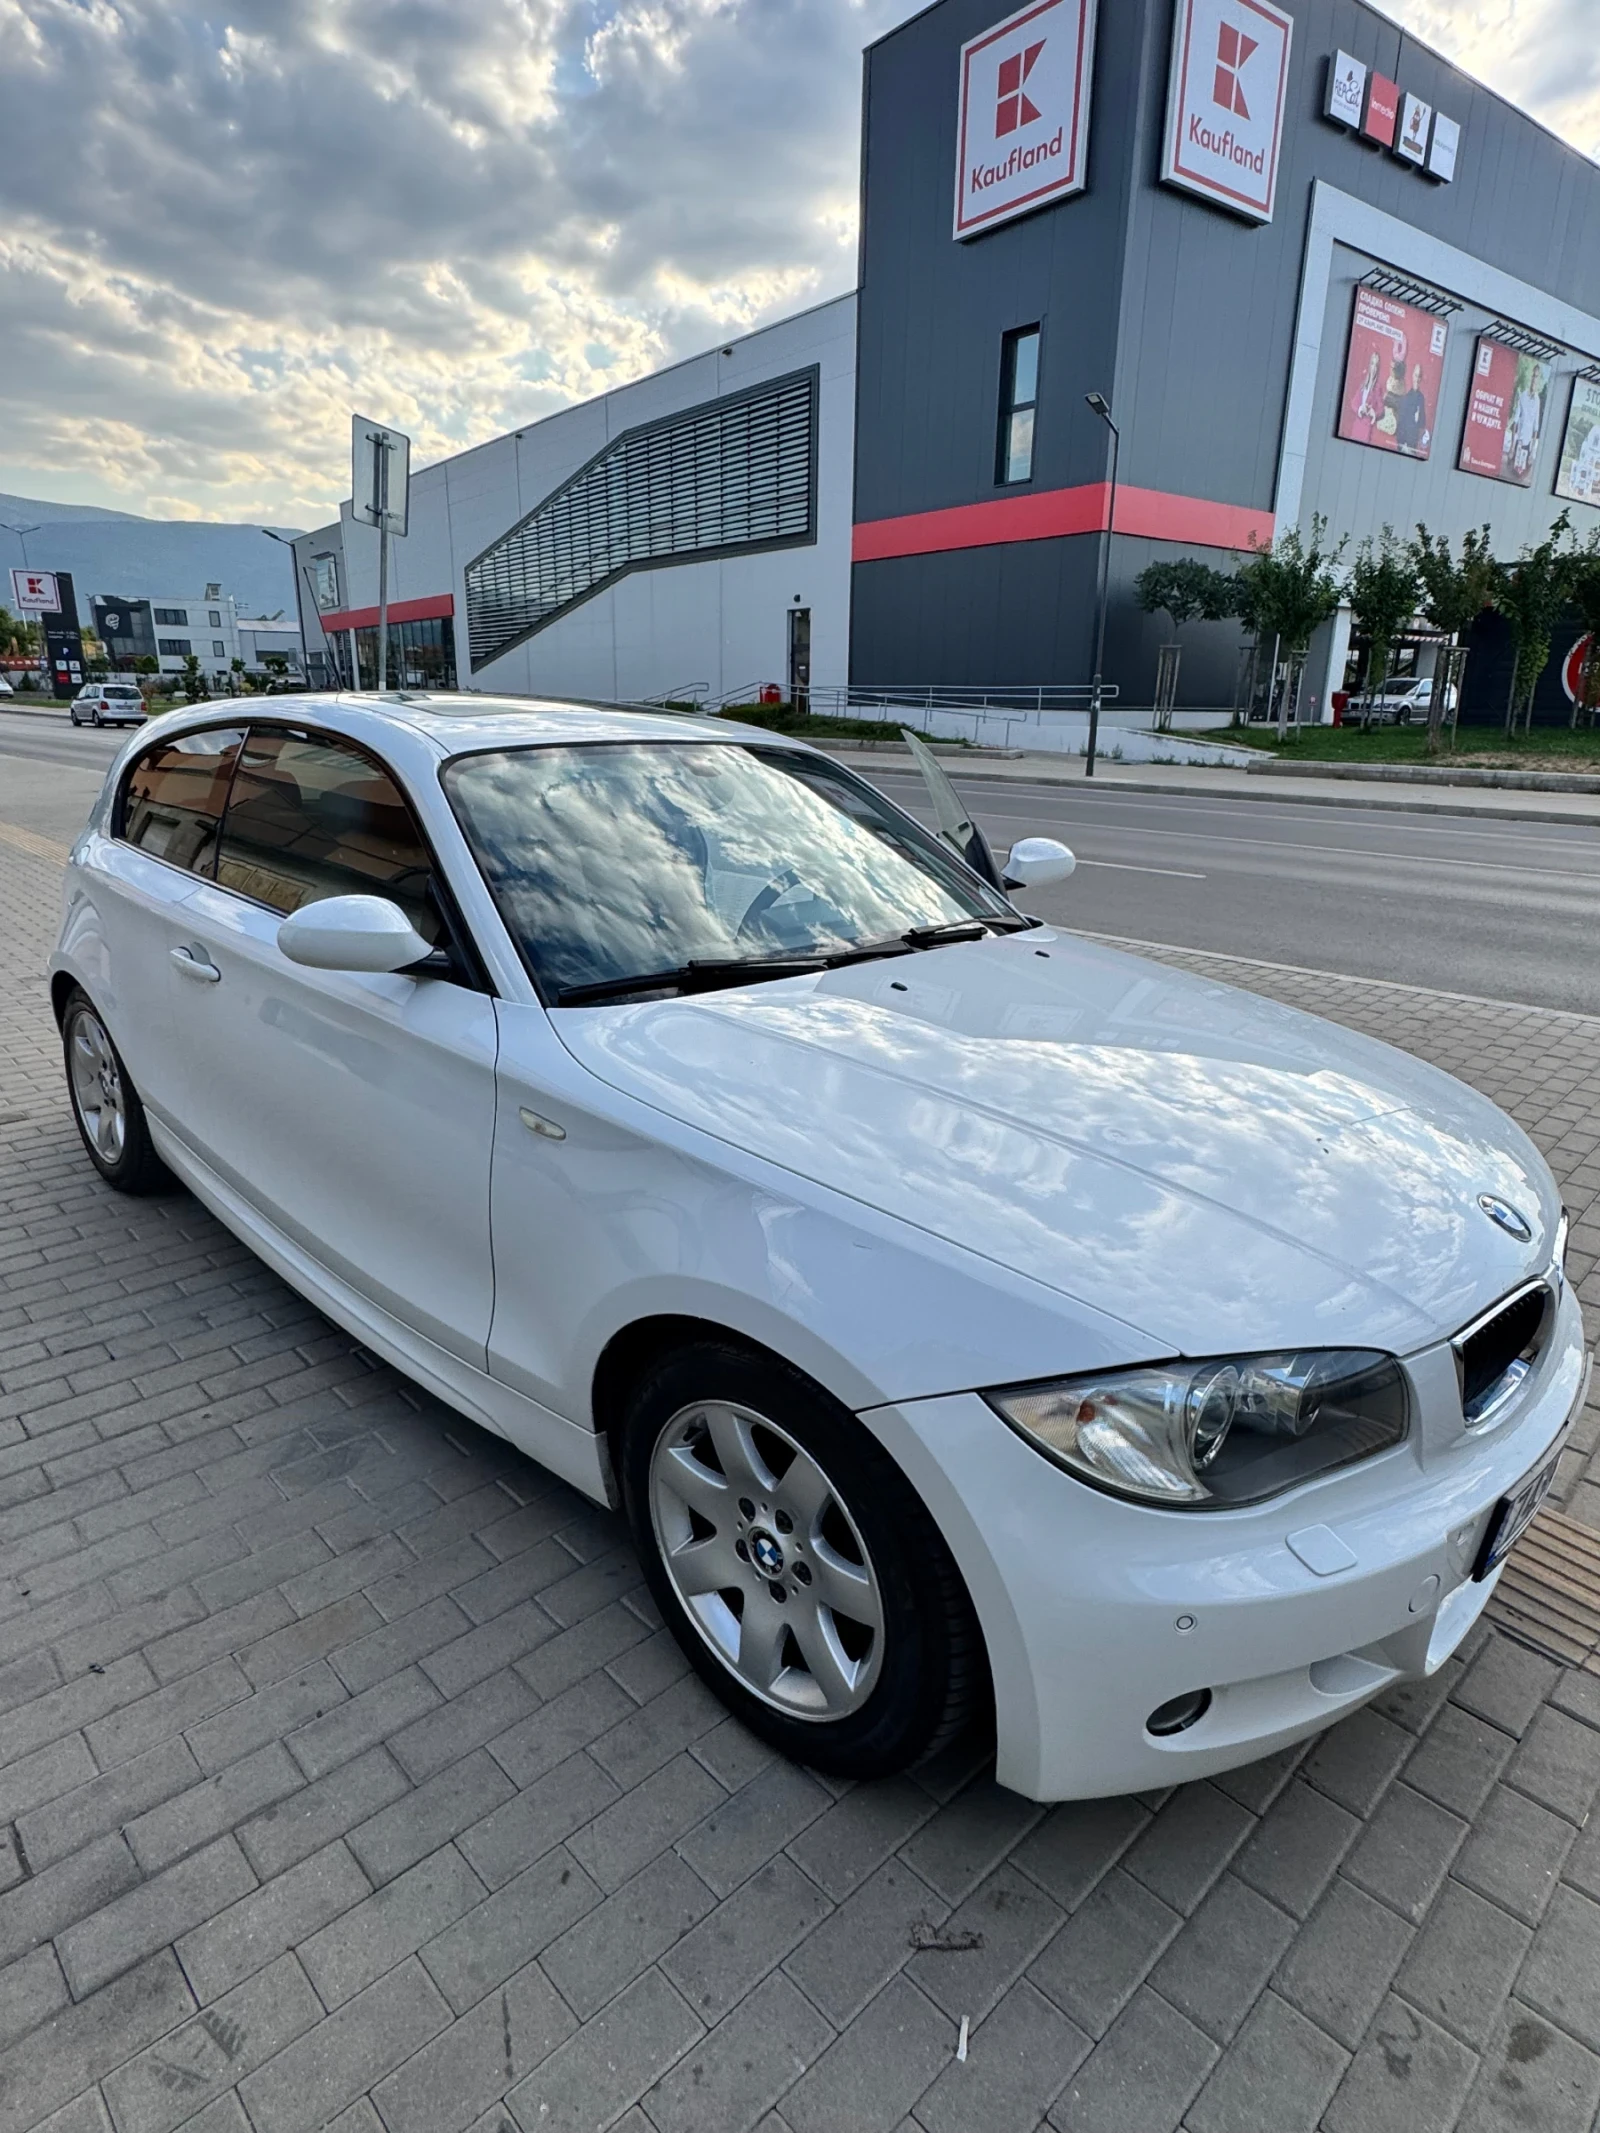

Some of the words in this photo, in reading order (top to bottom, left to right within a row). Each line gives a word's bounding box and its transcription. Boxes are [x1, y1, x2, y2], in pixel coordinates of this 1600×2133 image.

[970, 126, 1063, 194] Kaufland
[1188, 113, 1265, 175] Kaufland
[21, 596, 54, 605] Kaufland
